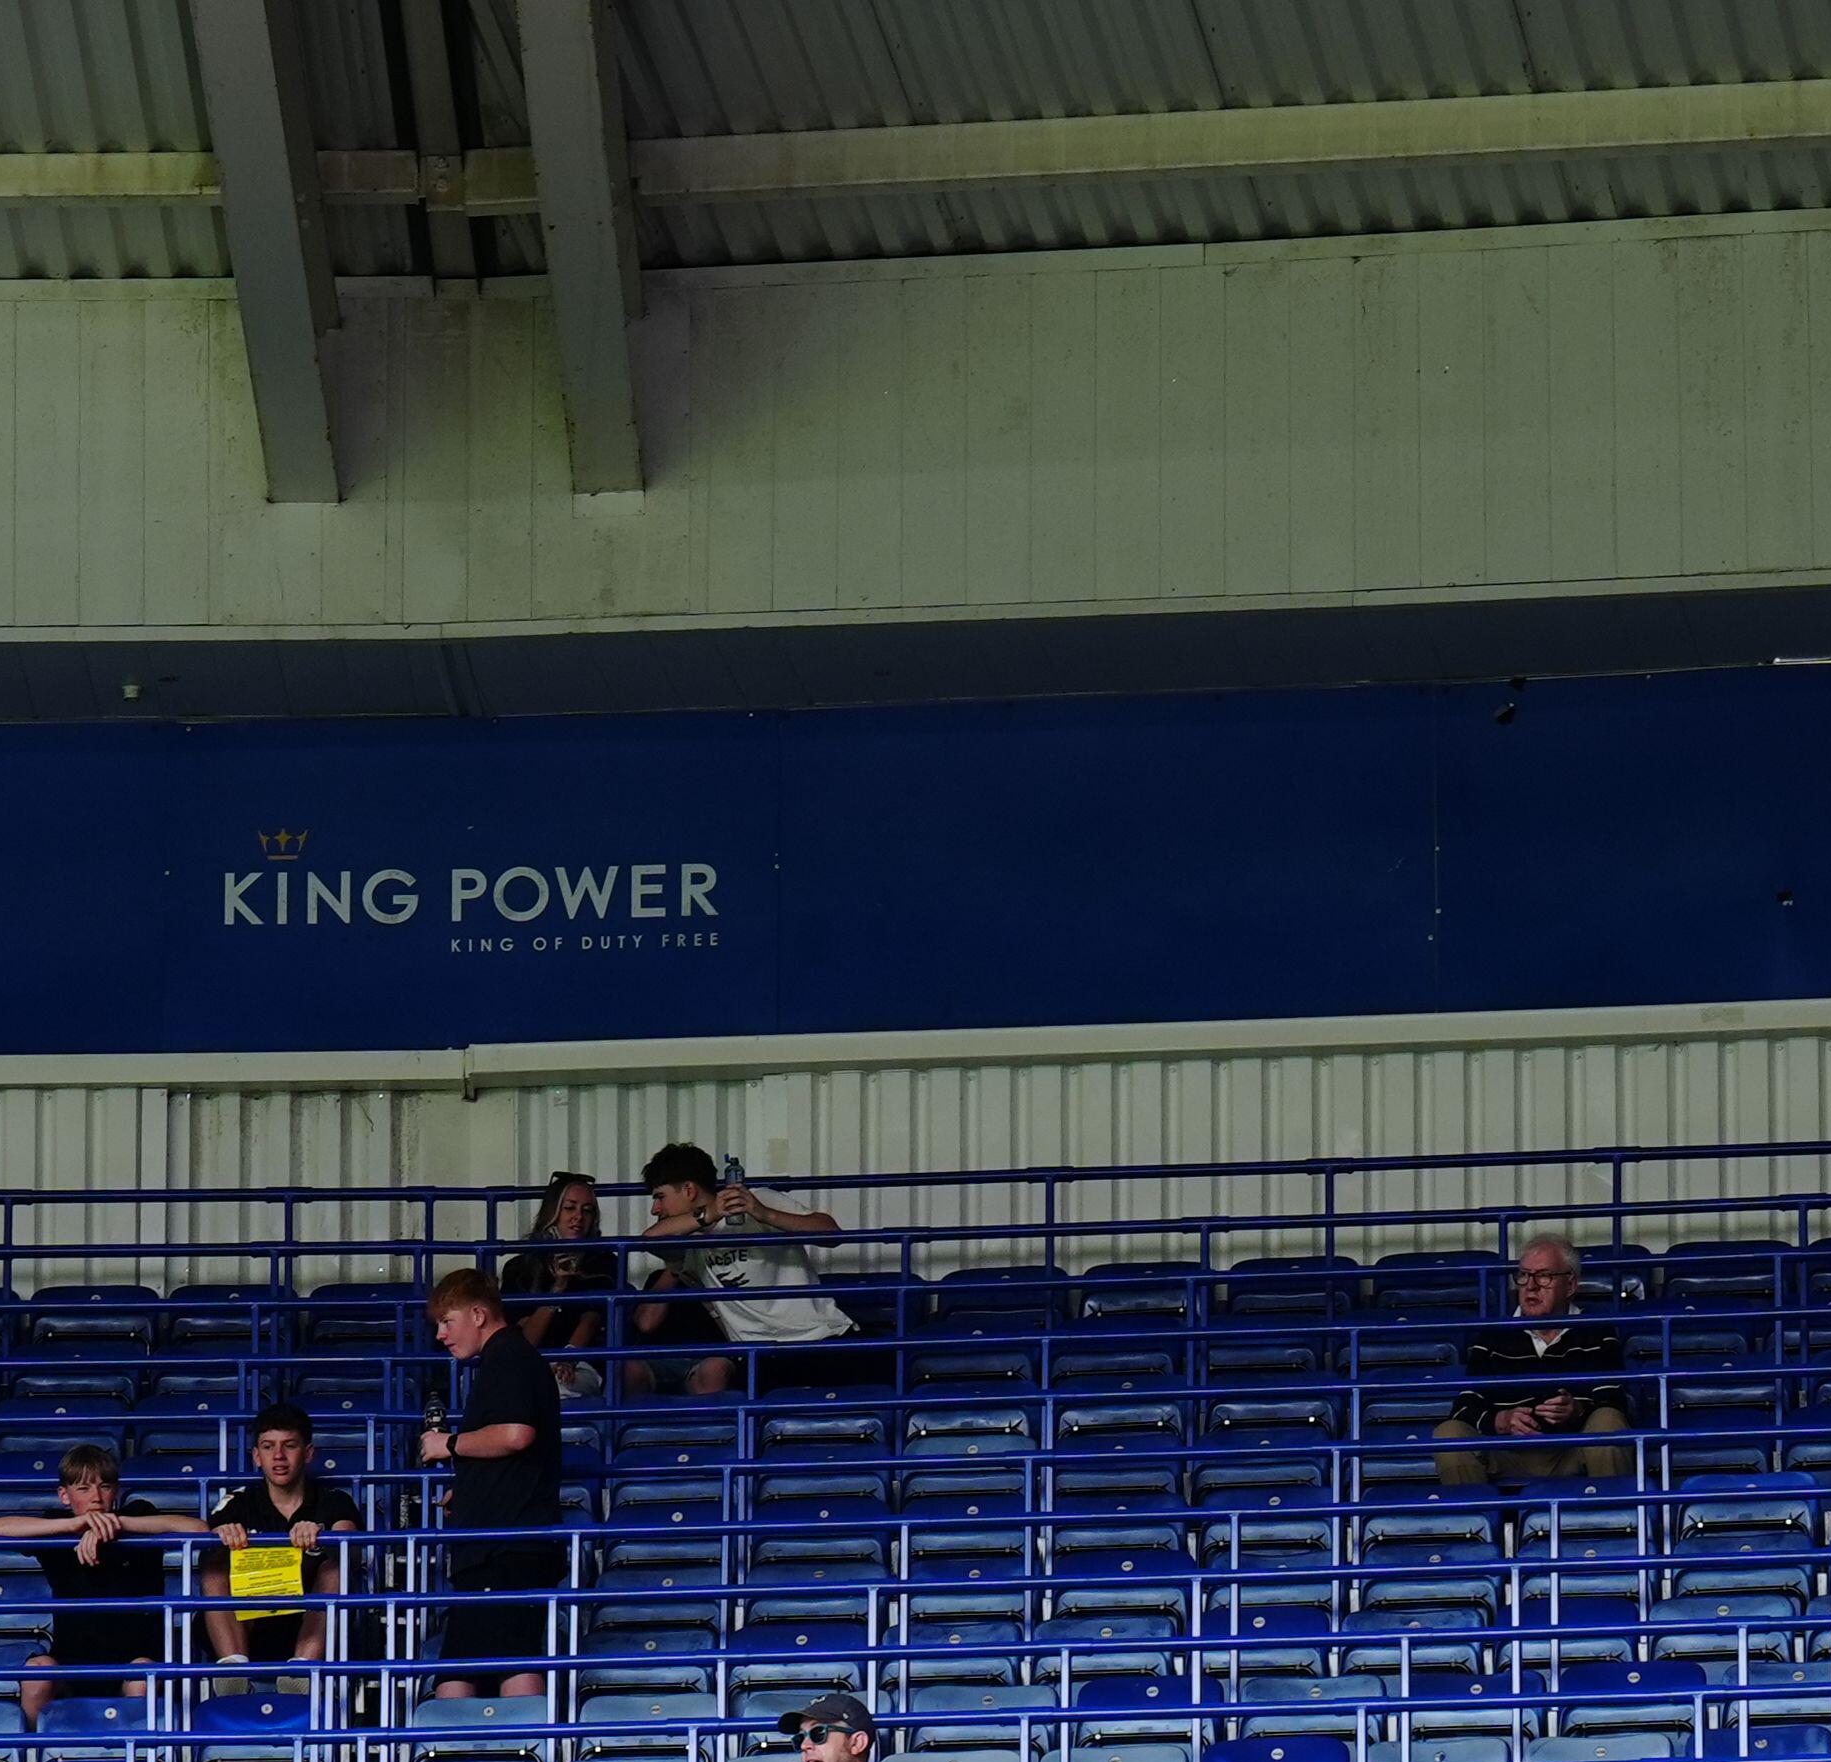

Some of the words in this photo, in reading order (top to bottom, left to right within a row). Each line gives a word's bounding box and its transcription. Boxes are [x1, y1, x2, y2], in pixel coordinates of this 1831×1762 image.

[224, 868, 419, 925] KING
[451, 863, 719, 922] POWER
[451, 937, 514, 953] KING
[532, 936, 563, 951] OF
[581, 934, 643, 950] DUTY
[662, 932, 719, 948] FREE
